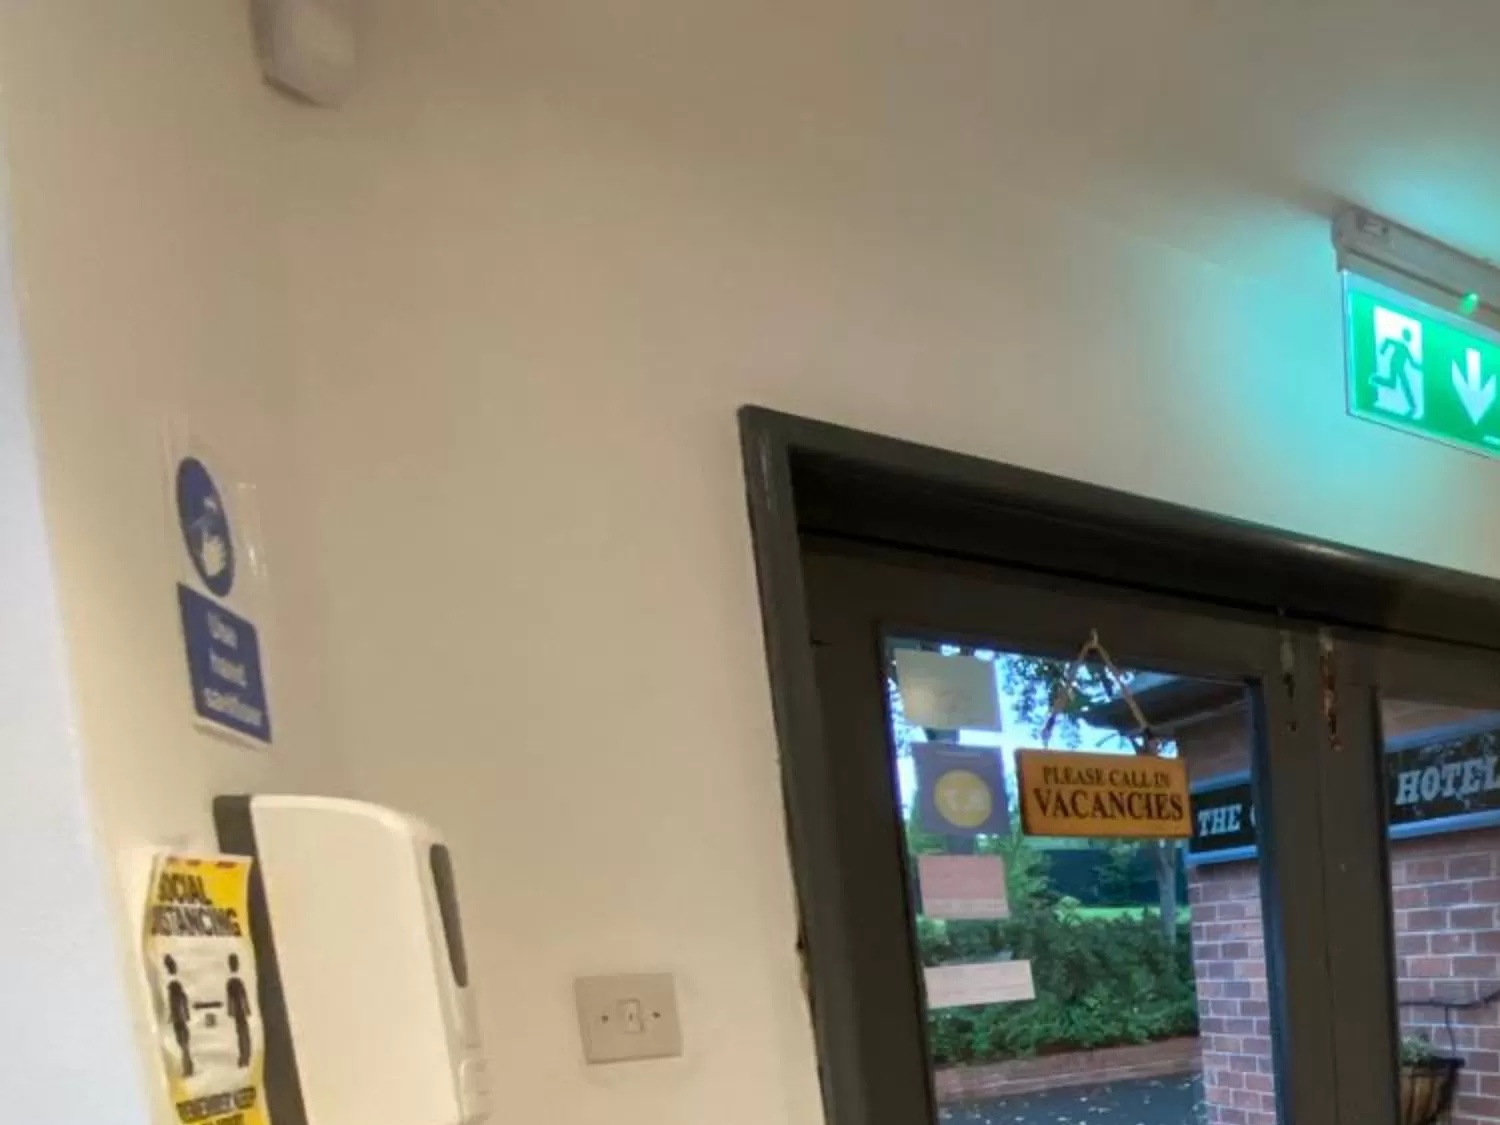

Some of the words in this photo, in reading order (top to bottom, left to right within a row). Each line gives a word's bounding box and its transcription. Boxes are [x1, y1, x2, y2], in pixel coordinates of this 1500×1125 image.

[1042, 765, 1105, 786] PLEASE
[1108, 768, 1152, 789] CALL
[1153, 771, 1172, 788] IN
[1032, 787, 1185, 821] VACANCIES
[1197, 803, 1243, 837] THE
